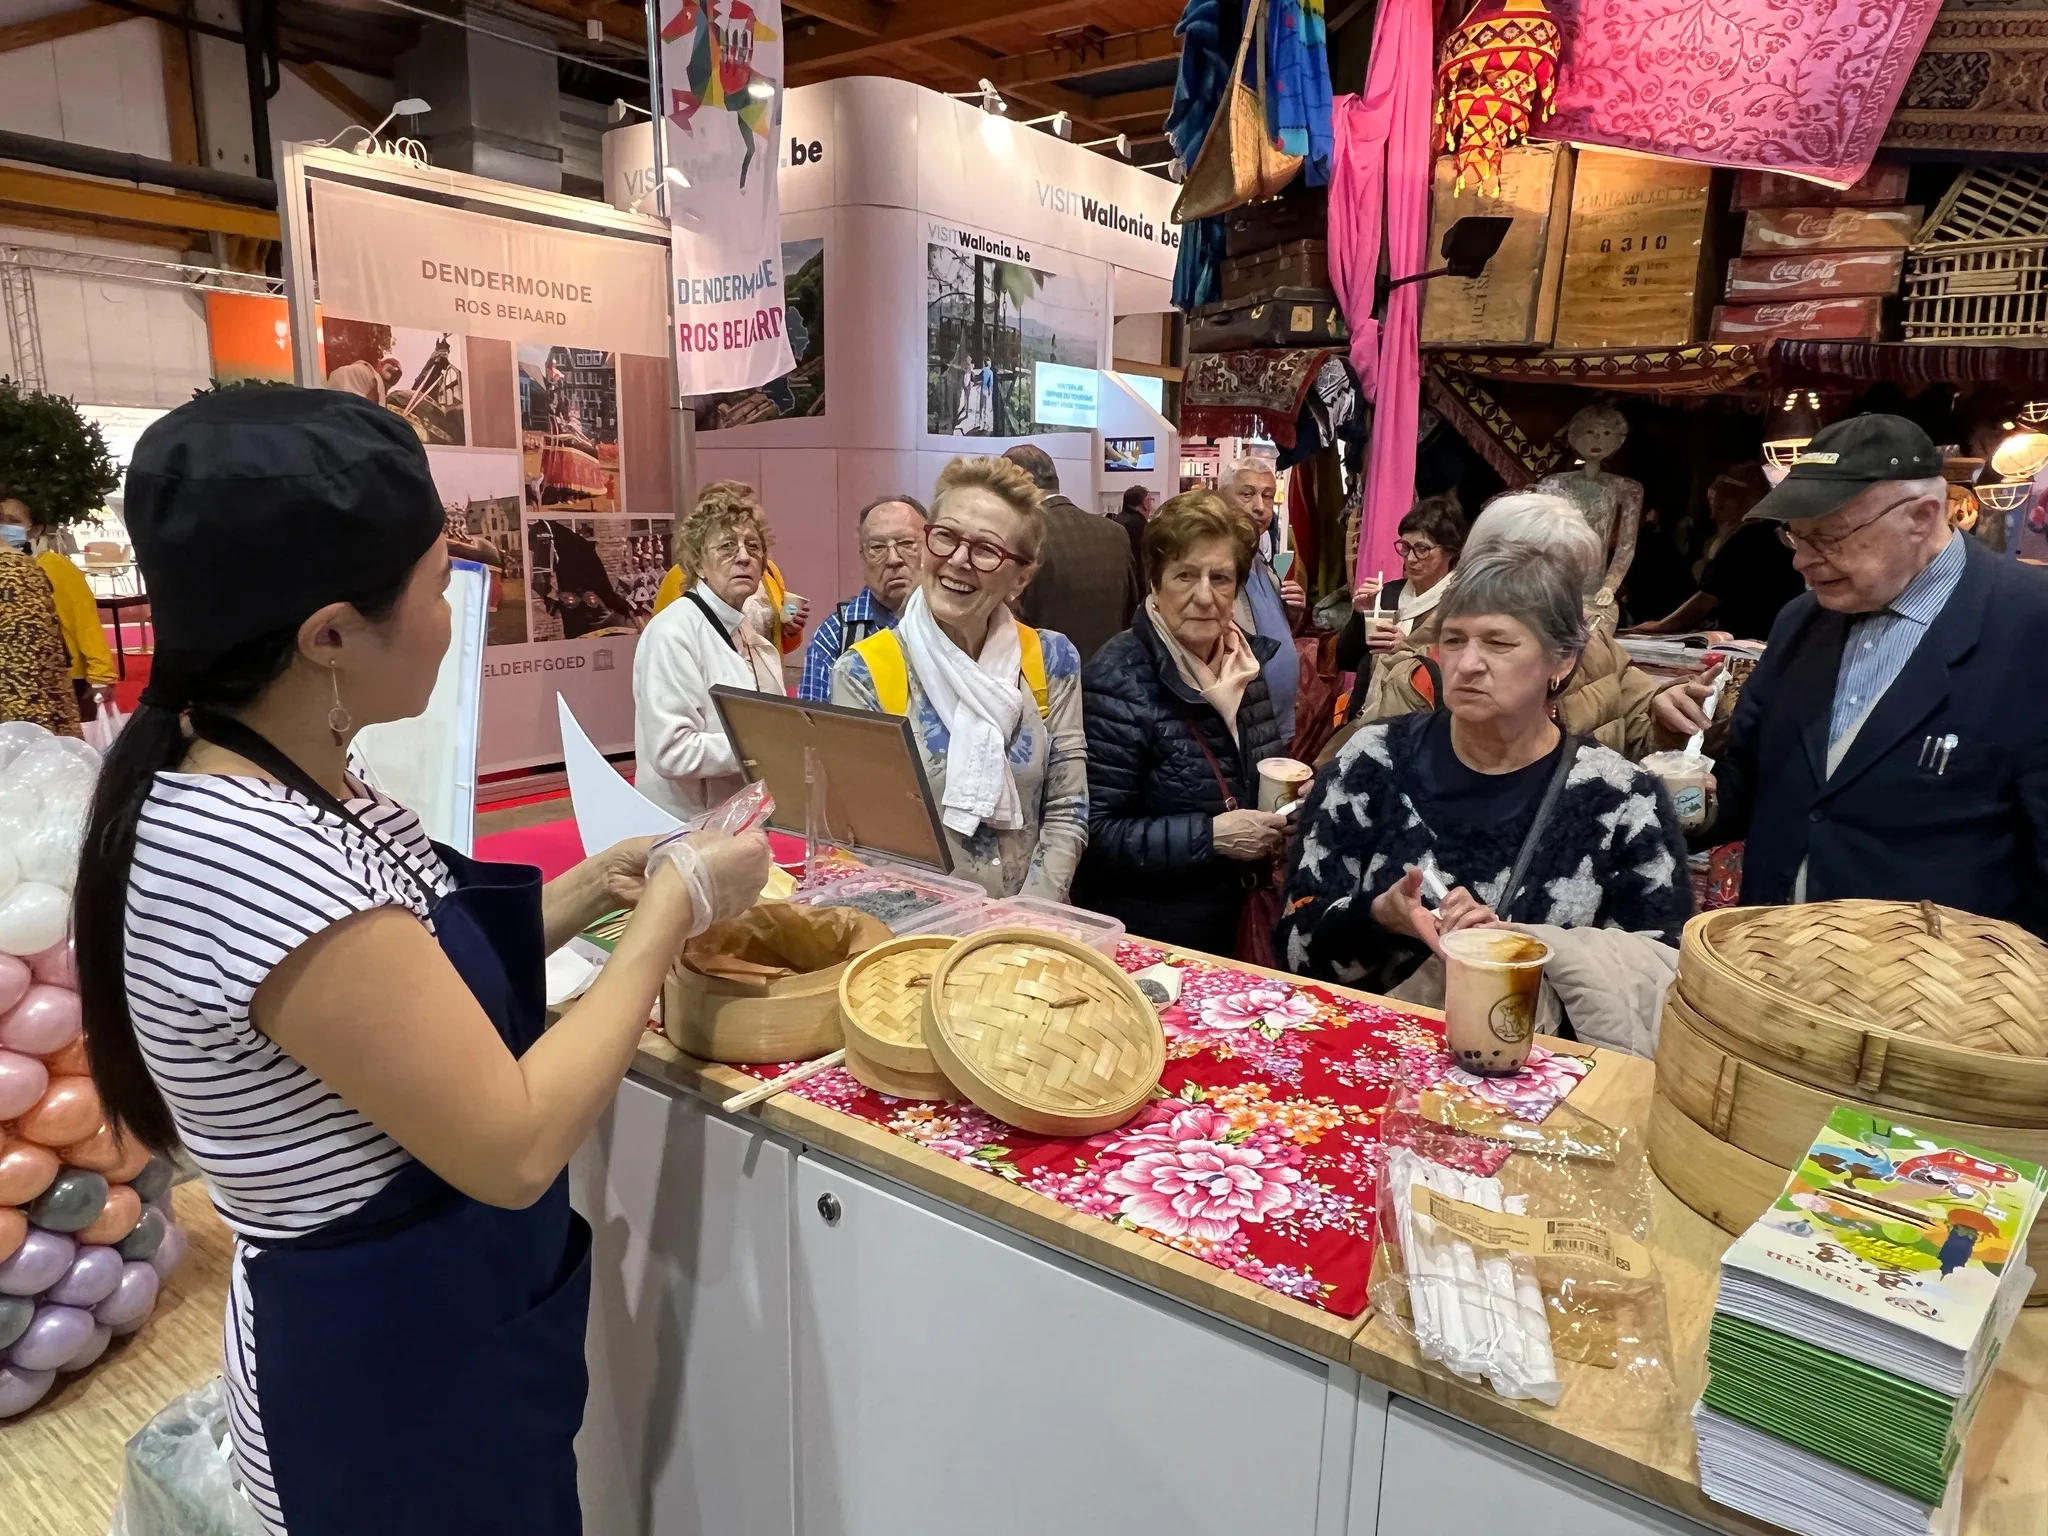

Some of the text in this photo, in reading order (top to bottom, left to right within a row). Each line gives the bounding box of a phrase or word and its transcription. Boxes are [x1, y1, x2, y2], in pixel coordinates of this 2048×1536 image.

[421, 259, 593, 304] DENDERMONDE
[454, 297, 567, 326] ROS BEIAARD
[680, 323, 719, 352] ROS
